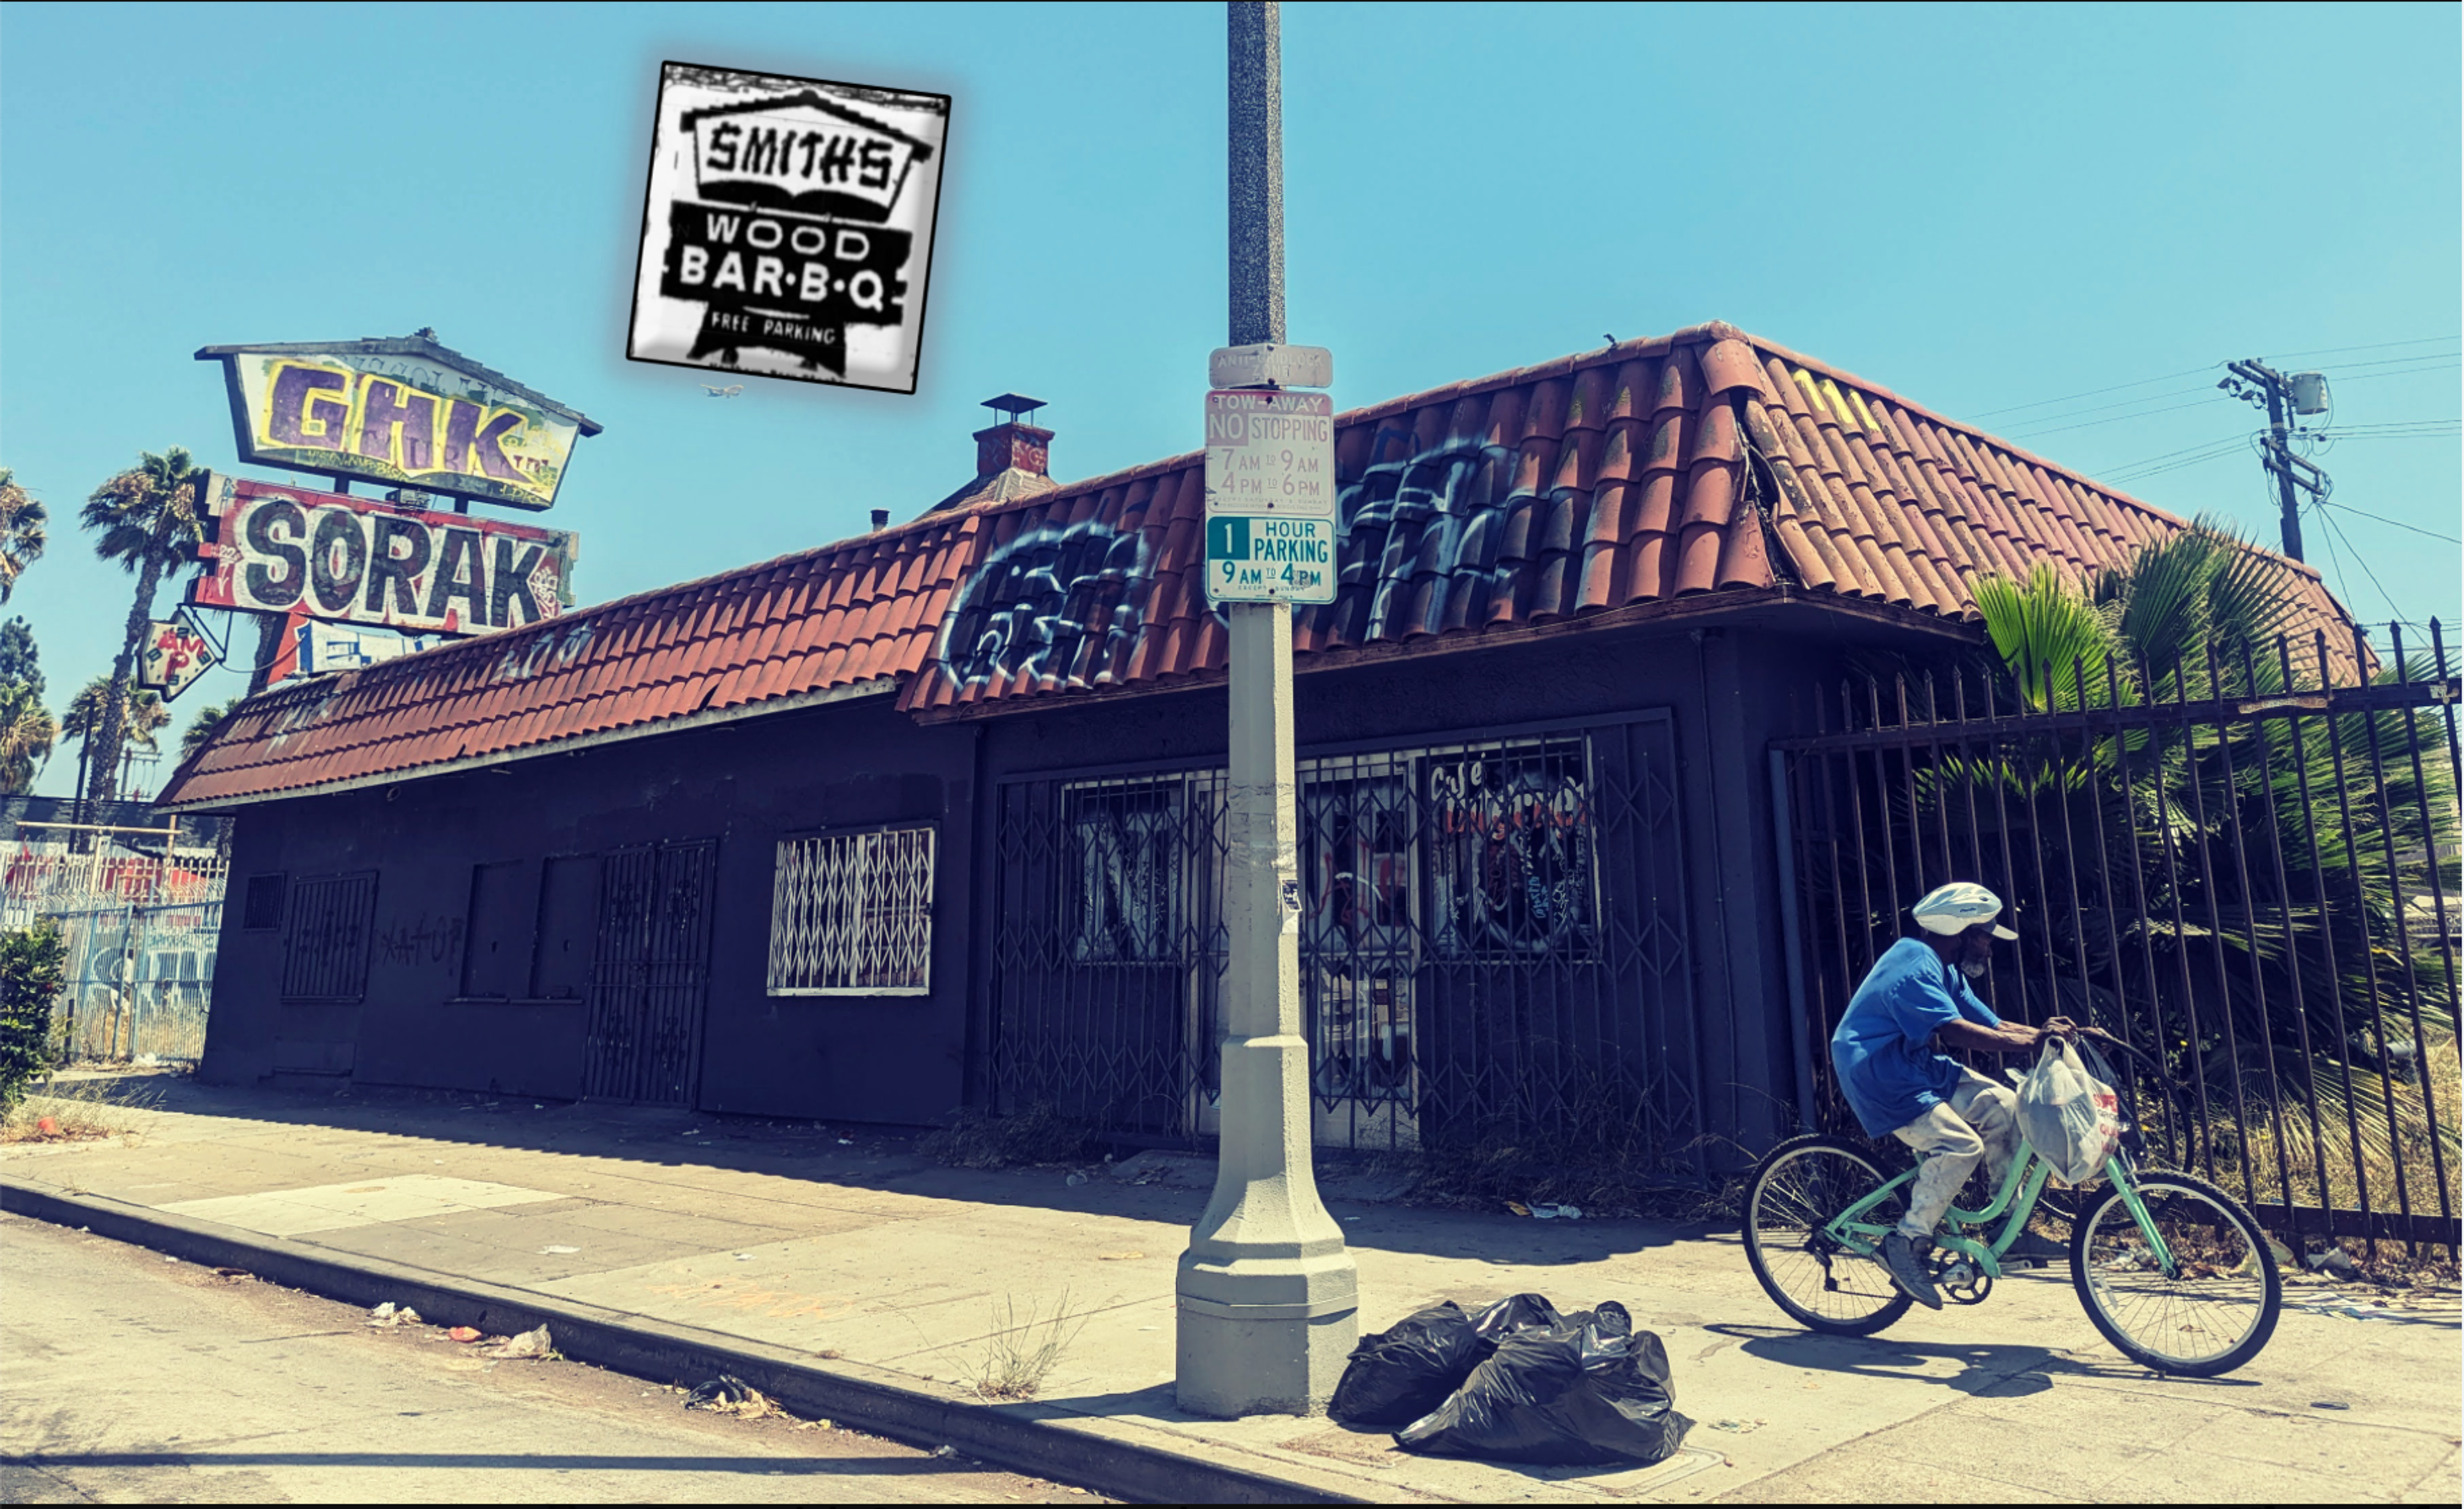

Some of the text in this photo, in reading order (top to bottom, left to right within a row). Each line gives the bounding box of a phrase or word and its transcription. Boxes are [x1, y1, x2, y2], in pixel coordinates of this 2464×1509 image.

[1218, 352, 1324, 368] ANTI-GRIDLOCK
[1253, 364, 1290, 377] ZONE
[1217, 394, 1324, 413] TOW-AWAY
[259, 358, 540, 486] GHK
[1209, 413, 1328, 442] NO STOPPING
[1222, 448, 1319, 473] 7 AM TO 9 AM
[1221, 472, 1319, 496] 4 PM TO 6 PM
[1224, 521, 1315, 554] 1 HOUR
[1254, 538, 1328, 563] PARKING
[237, 495, 548, 633] SORAK
[1222, 561, 1236, 584] 9
[1239, 568, 1262, 584] AM
[1266, 568, 1276, 576] TO
[1280, 563, 1294, 586] 4
[1299, 570, 1321, 586] PM
